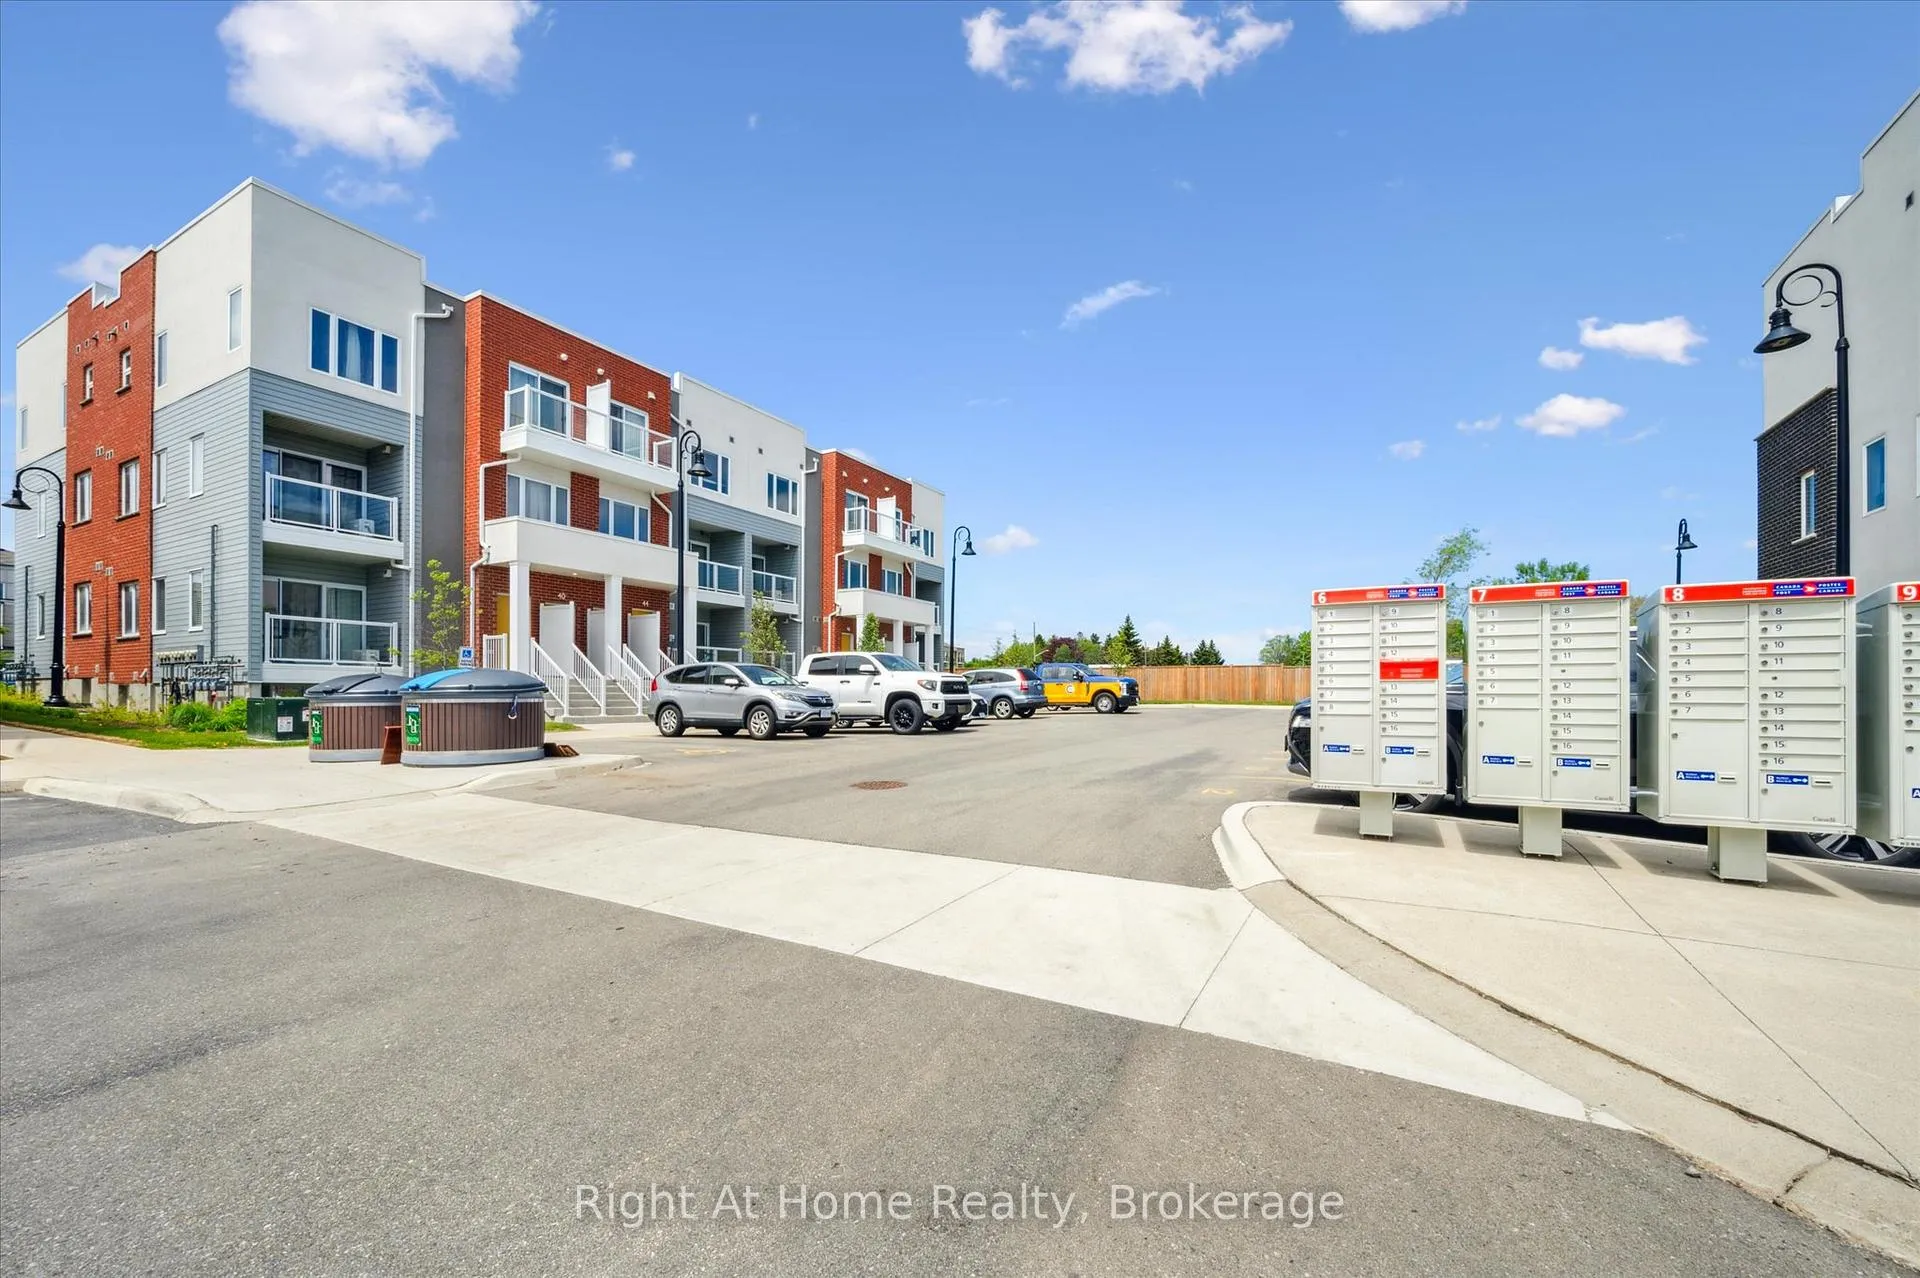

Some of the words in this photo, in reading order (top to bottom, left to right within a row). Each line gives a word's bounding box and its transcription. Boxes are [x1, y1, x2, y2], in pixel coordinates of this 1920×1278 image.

[1477, 589, 1487, 601] 7
[1672, 588, 1684, 601] 8
[1902, 585, 1917, 600] 9
[1318, 592, 1327, 604] 6
[1775, 641, 1785, 649] 10
[1775, 657, 1784, 665] 11
[1775, 691, 1784, 699] 12
[1774, 740, 1785, 748] 15
[1774, 756, 1785, 764] 16
[1677, 771, 1684, 780] A
[1767, 775, 1775, 783] B
